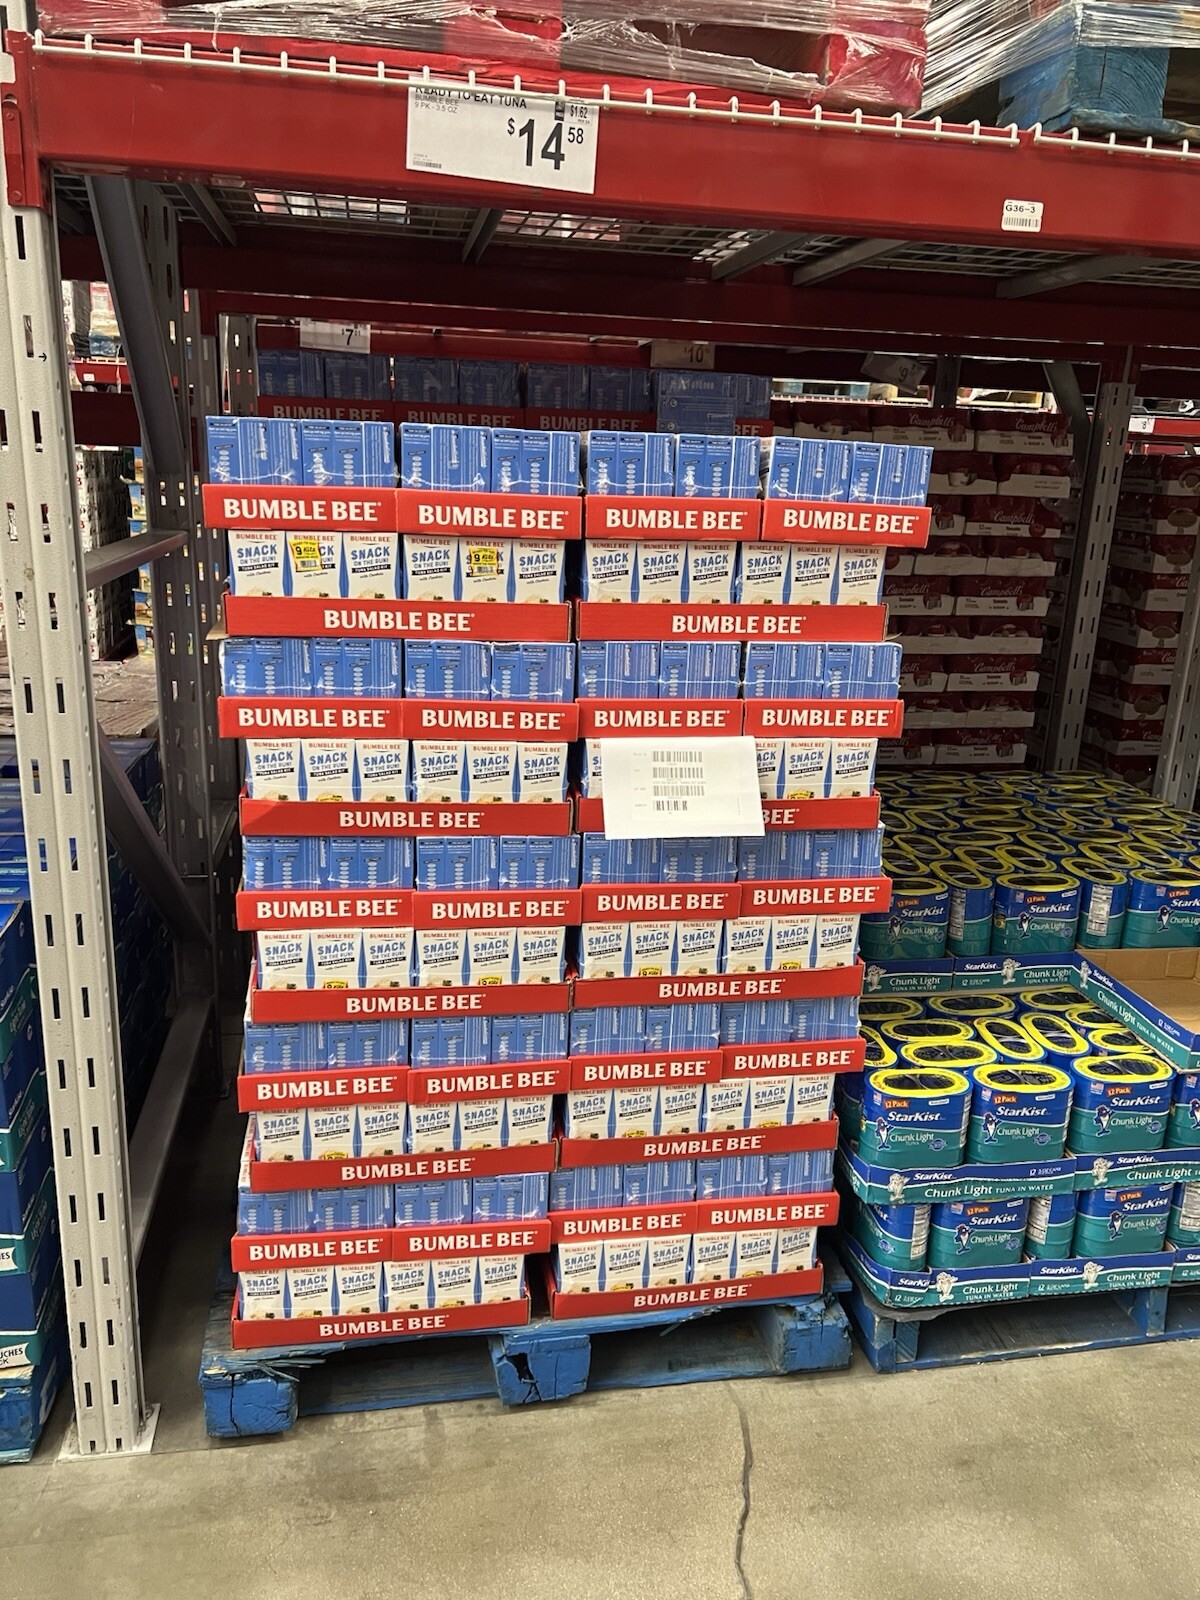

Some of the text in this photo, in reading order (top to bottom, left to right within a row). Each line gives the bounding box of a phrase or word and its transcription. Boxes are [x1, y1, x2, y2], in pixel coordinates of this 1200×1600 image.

[415, 95, 444, 104] BUMBLE
[458, 91, 470, 100] TO
[474, 94, 494, 104] EAT
[500, 96, 526, 108] TUNA
[570, 104, 588, 119] $1.62
[1005, 204, 1036, 214] G36-3
[223, 498, 378, 521] BUMBLE BEE
[418, 505, 565, 530] BUMBLE BEE
[606, 508, 744, 530] BUMBLE BEE
[783, 509, 916, 534] BUMBLE BEE
[236, 544, 277, 559] SNACK
[519, 553, 557, 567] SNACK
[592, 553, 629, 567] SNACK
[844, 558, 878, 571] SNACK
[324, 610, 471, 631] BUMBLE BEE
[672, 615, 802, 634] BUMBLE BEE
[238, 708, 386, 728] BUMBLE BEE
[422, 709, 561, 730] BUMBLE BEE
[594, 710, 726, 727] BUMBLE BEE
[762, 709, 890, 726] BUMBLE BEE
[255, 751, 293, 764] SNACK
[836, 751, 870, 764] SNACK
[339, 811, 480, 828] BUMBLE BEE
[762, 808, 796, 824] BEE
[598, 894, 724, 911] BUMBLE BEE
[753, 886, 876, 905] BUMBLE BEE
[256, 899, 398, 918] BUMBLE BEE
[432, 900, 565, 919] BUMBLE BEE
[901, 906, 944, 917] StarKist
[1029, 903, 1071, 913] StarKist
[821, 925, 853, 938] SNACK
[890, 977, 940, 986] Chunk Light
[1024, 969, 1072, 980] Chunk Light
[1093, 970, 1114, 987] StarKist
[659, 979, 782, 998] BUMBLE BEE
[346, 994, 482, 1013] BUMBLE BEE
[1098, 991, 1135, 1025] Chunk Light
[734, 1050, 852, 1070] BUMBLE BEE
[584, 1061, 706, 1081] BUMBLE BEE
[257, 1076, 394, 1100] BUMBLE BEE
[427, 1070, 556, 1094] BUMBLE BEE
[711, 1090, 742, 1102] SNACK
[1110, 1096, 1161, 1107] StarKist
[364, 1112, 399, 1126] SNACK
[888, 1111, 940, 1121] StarKist
[996, 1106, 1047, 1116] StarKist
[1110, 1116, 1153, 1127] Chunk Light
[890, 1132, 934, 1143] Chunk Light
[997, 1126, 1040, 1136] Chunk Light
[644, 1136, 762, 1156] BUMBLE BEE
[1117, 1155, 1154, 1164] StarKist
[342, 1158, 471, 1180] BUMBLE BEE
[1127, 1167, 1192, 1181] Chunk Light
[925, 1188, 961, 1198] Chunk
[964, 1185, 992, 1198] Light
[1122, 1198, 1168, 1212] StarKist
[711, 1204, 826, 1224] BUMBLE BEE
[969, 1214, 1017, 1225] StarKist
[564, 1214, 682, 1235] BUMBLE BEE
[409, 1231, 534, 1252] BUMBLE BEE
[970, 1233, 1011, 1244] Chunk Light
[249, 1238, 380, 1261] BUMBLE BEE
[1107, 1271, 1161, 1282] Chunk Light
[634, 1284, 748, 1307] BUMBLE BEE
[963, 1283, 1018, 1295] Chunk Light
[319, 1315, 446, 1336] BUMBLE BEE
